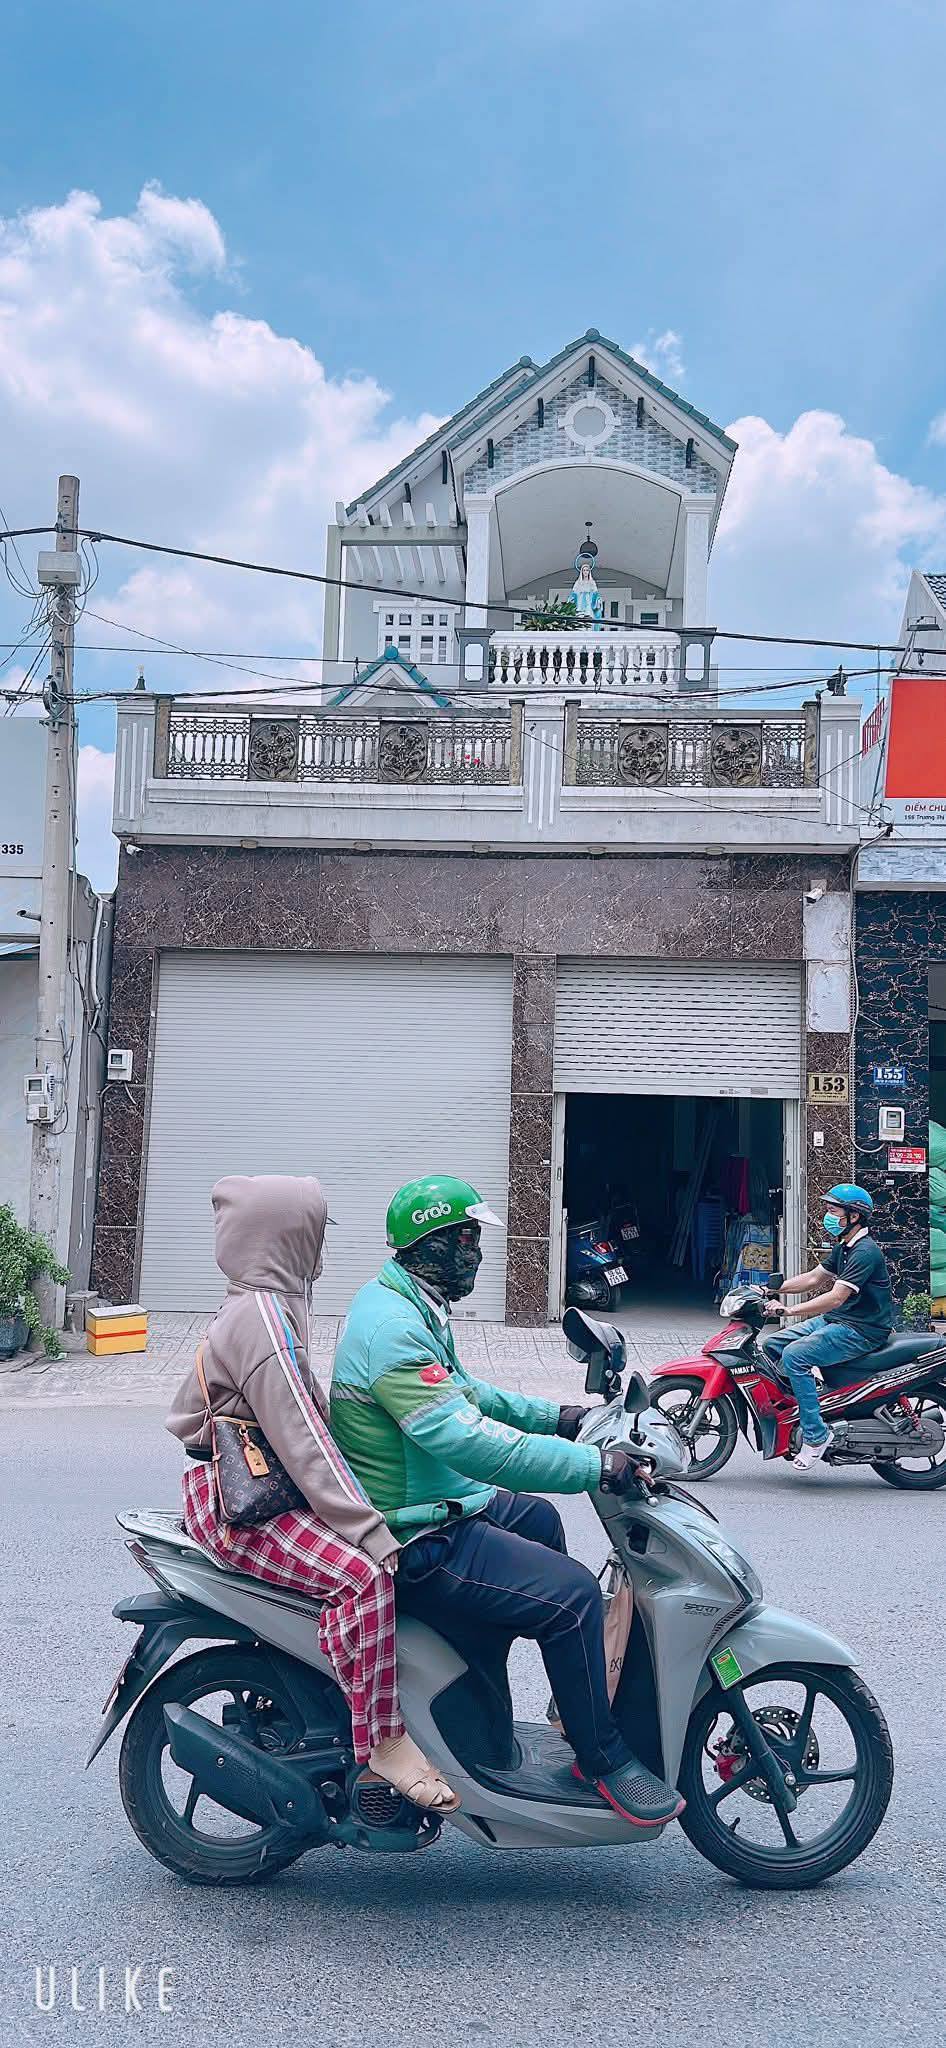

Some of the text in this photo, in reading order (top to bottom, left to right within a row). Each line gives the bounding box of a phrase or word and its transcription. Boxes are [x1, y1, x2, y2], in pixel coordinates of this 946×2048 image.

[1, 843, 24, 855] 335
[876, 1067, 903, 1080] 155
[812, 1076, 846, 1092] 153
[411, 1201, 452, 1225] Grab
[683, 1602, 722, 1615] SPORTY
